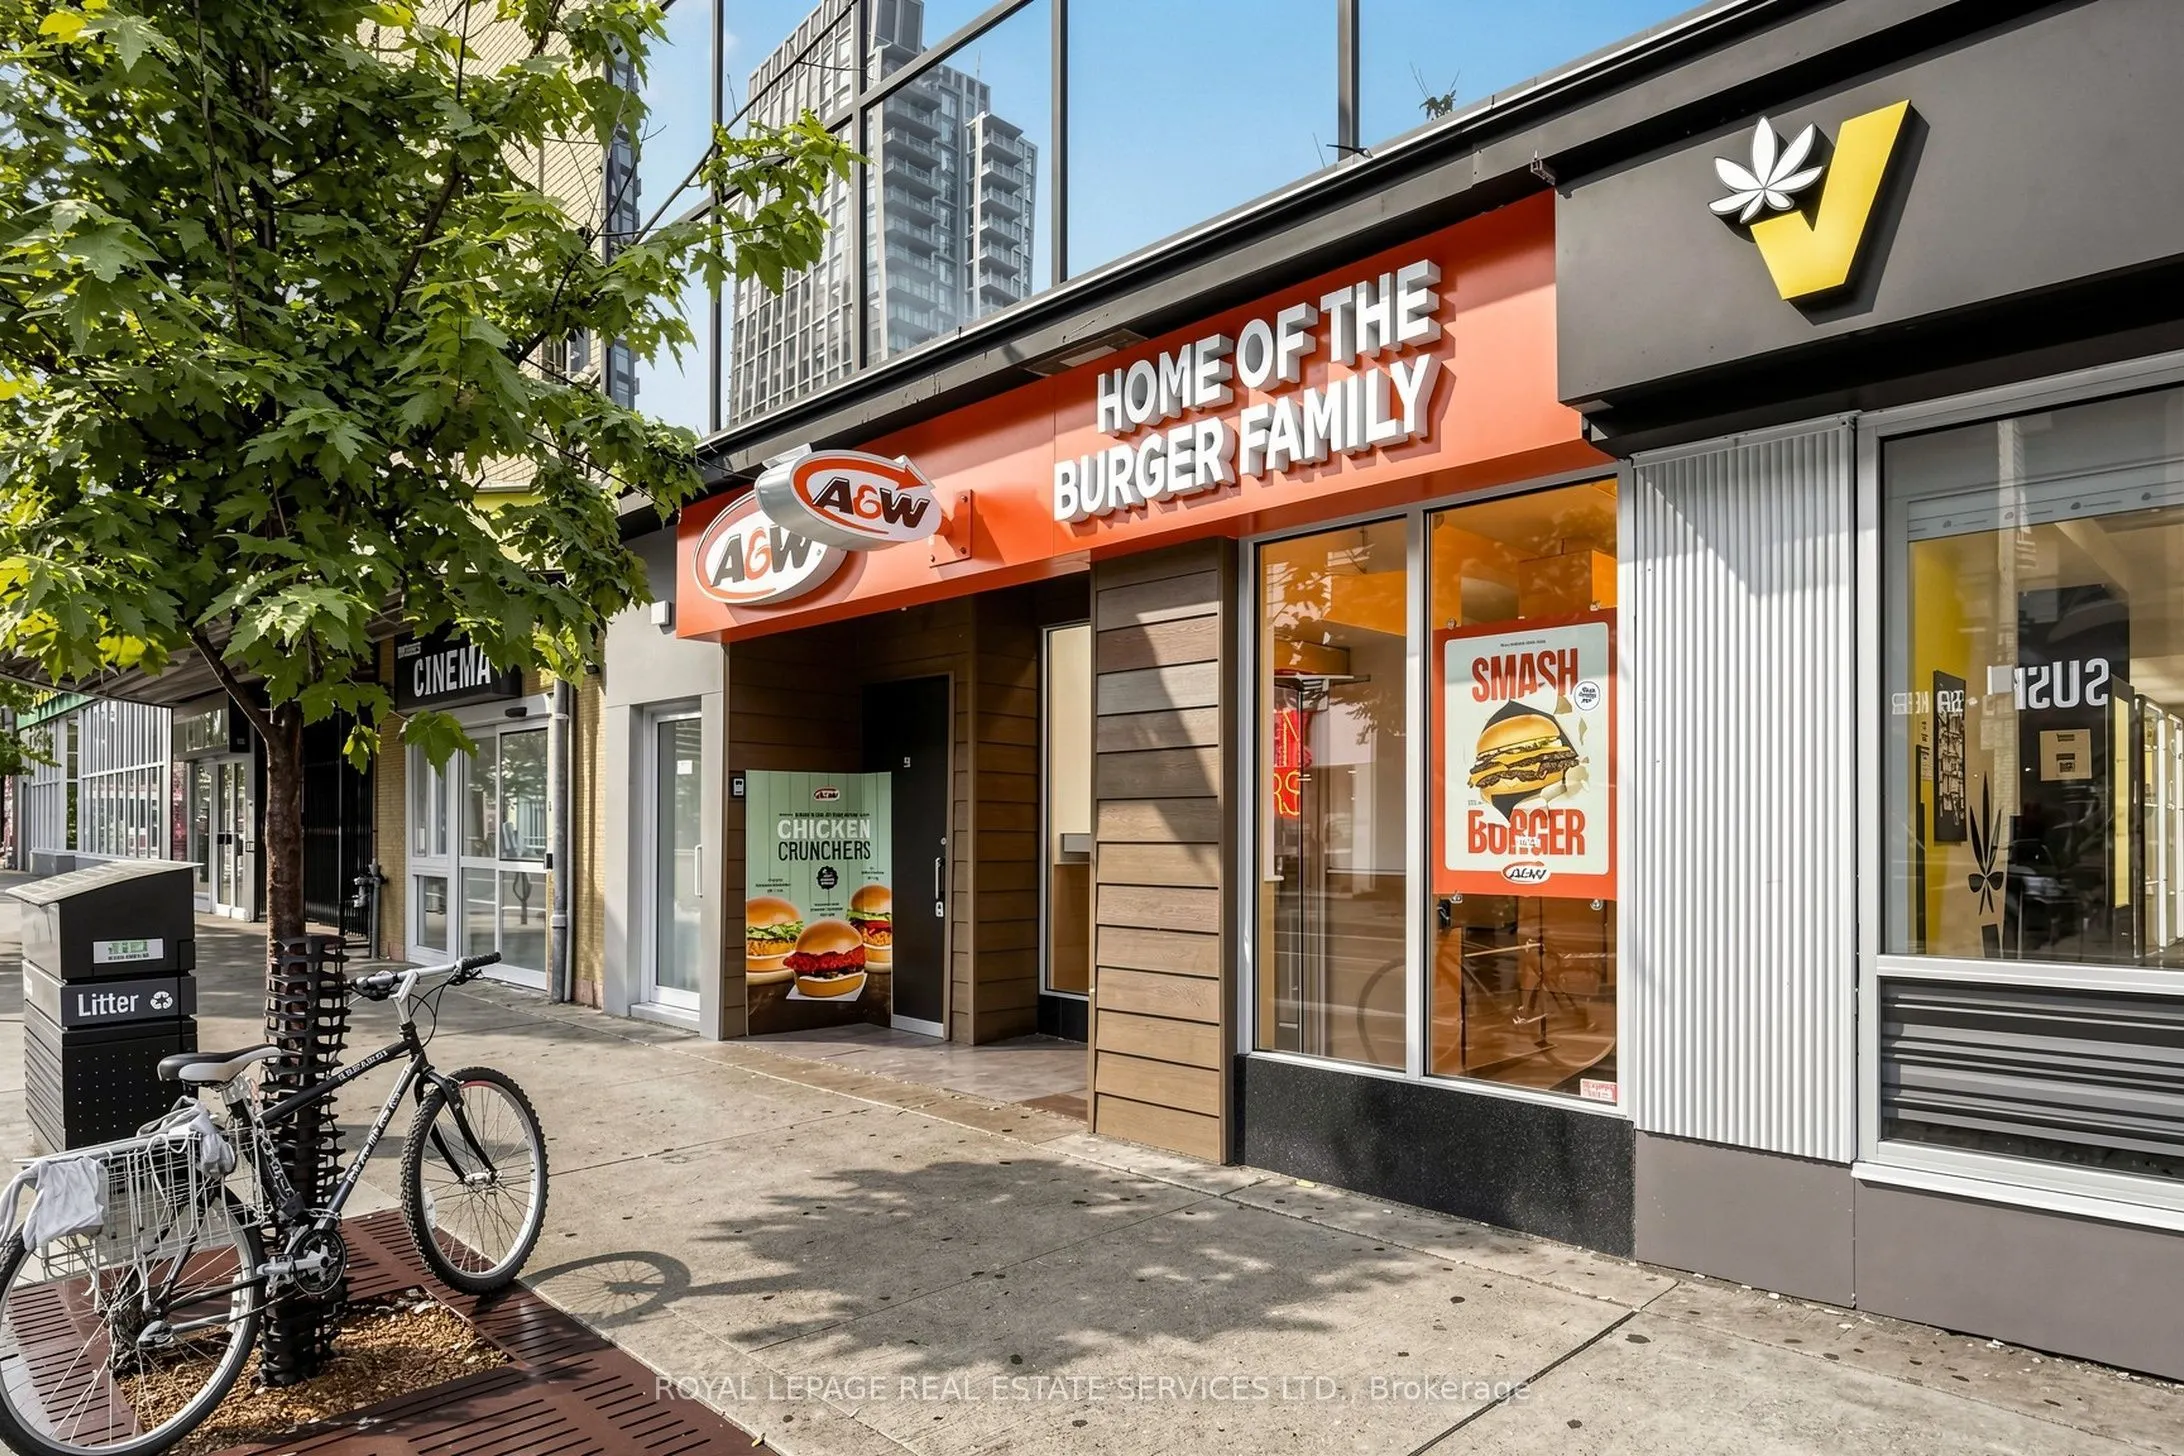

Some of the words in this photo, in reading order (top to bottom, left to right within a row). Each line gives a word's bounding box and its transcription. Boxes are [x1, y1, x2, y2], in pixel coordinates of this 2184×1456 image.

[1097, 333, 1232, 435] HOME
[1236, 302, 1317, 389] OF
[1320, 259, 1441, 366] THE
[1054, 416, 1235, 522] BURGER
[1240, 353, 1441, 478] FAMILY
[812, 476, 930, 528] A&W
[710, 523, 812, 588] A&W
[413, 643, 491, 697] CINEMA
[1472, 648, 1579, 702] SMASH
[777, 819, 871, 840] CHICKEN
[778, 841, 871, 861] CRUNCHERS
[78, 993, 139, 1017] Litter
